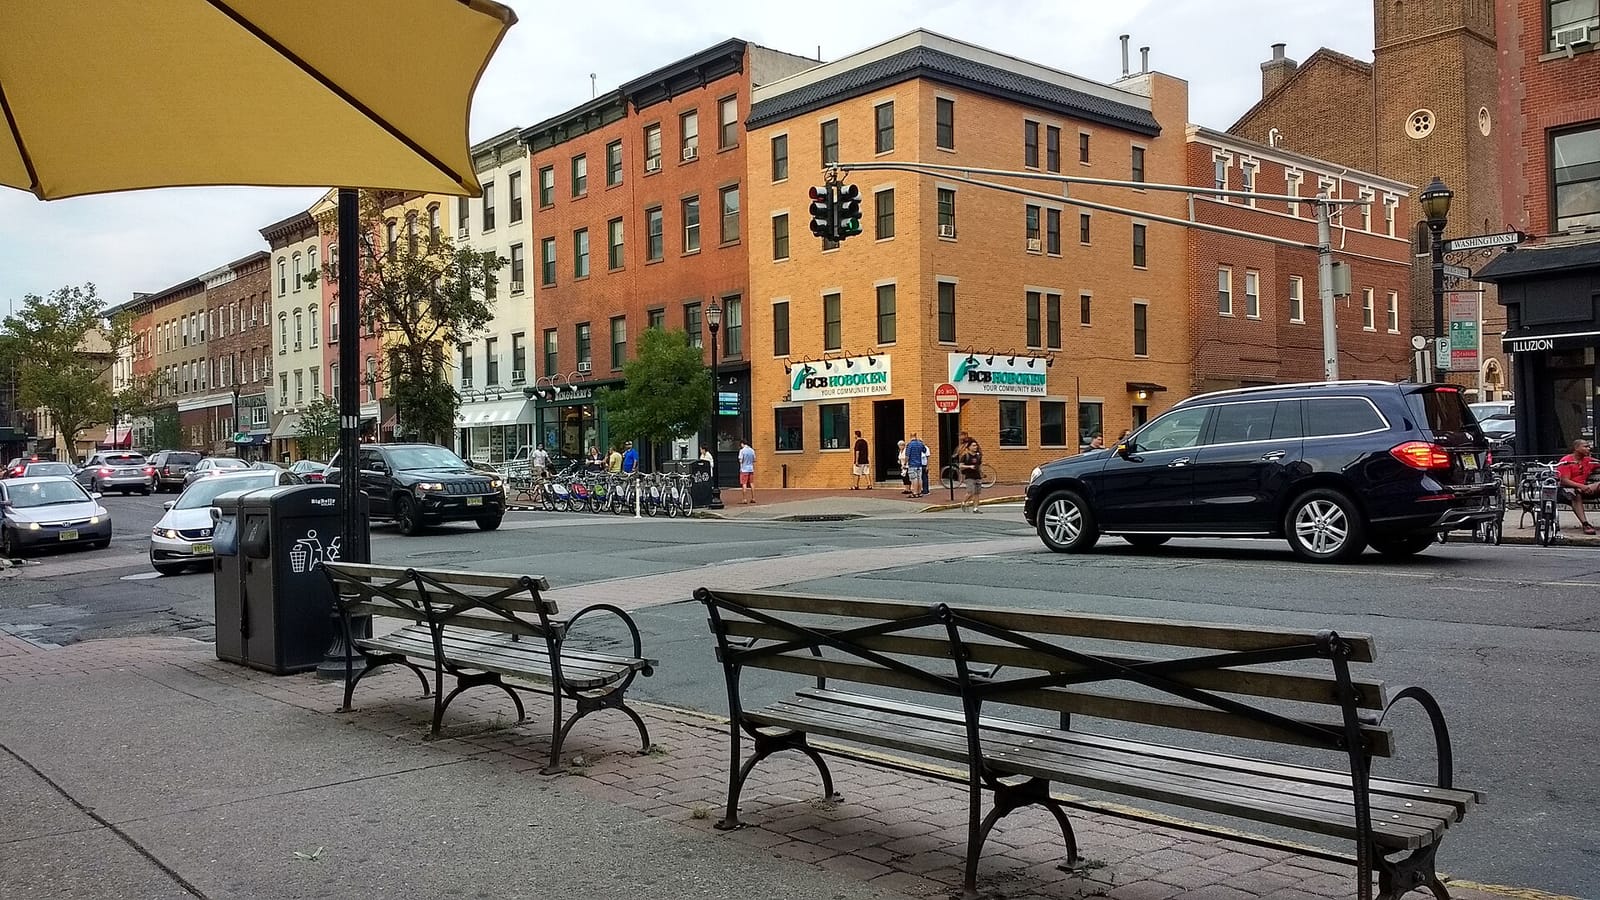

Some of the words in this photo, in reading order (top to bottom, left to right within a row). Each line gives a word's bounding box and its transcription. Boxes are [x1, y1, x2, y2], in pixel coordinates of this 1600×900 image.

[1454, 235, 1504, 248] WASHINGTON
[1453, 322, 1459, 330] 2
[1440, 341, 1447, 350] P
[1513, 339, 1553, 352] ILLUZION
[806, 376, 828, 389] BCB
[828, 372, 887, 387] HOBOKEN
[968, 370, 992, 383] BCB
[992, 371, 1046, 385] HOBOKEN
[821, 388, 836, 396] YOUR
[836, 386, 870, 395] COMMUNITY
[871, 385, 887, 393] BANK
[998, 385, 1030, 393] COMMUNITY
